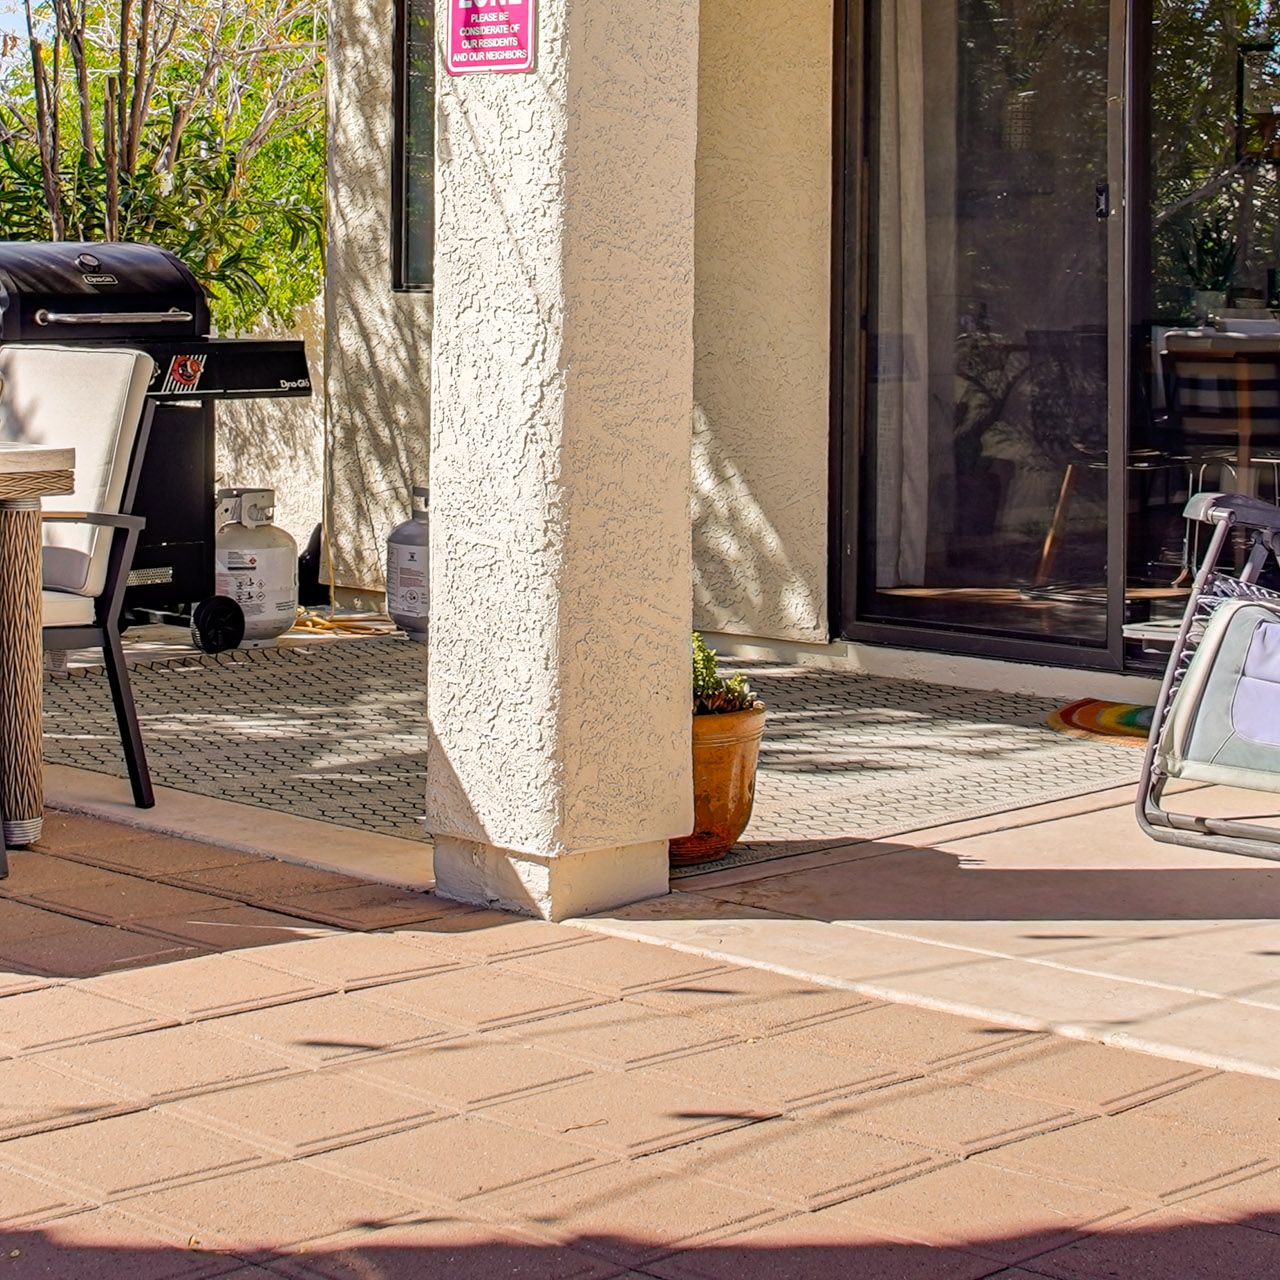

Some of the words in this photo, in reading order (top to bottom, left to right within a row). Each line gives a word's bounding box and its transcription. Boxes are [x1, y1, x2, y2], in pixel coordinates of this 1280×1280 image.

[471, 12, 498, 23] PLEASE
[499, 11, 510, 21] BE
[459, 24, 509, 36] CONSIDERATE
[510, 23, 520, 33] OF
[461, 39, 478, 49] OUR
[478, 37, 518, 48] RESIDENTS
[452, 52, 468, 62] AND
[468, 51, 485, 61] OUR
[485, 49, 528, 60] NEIGHBORS
